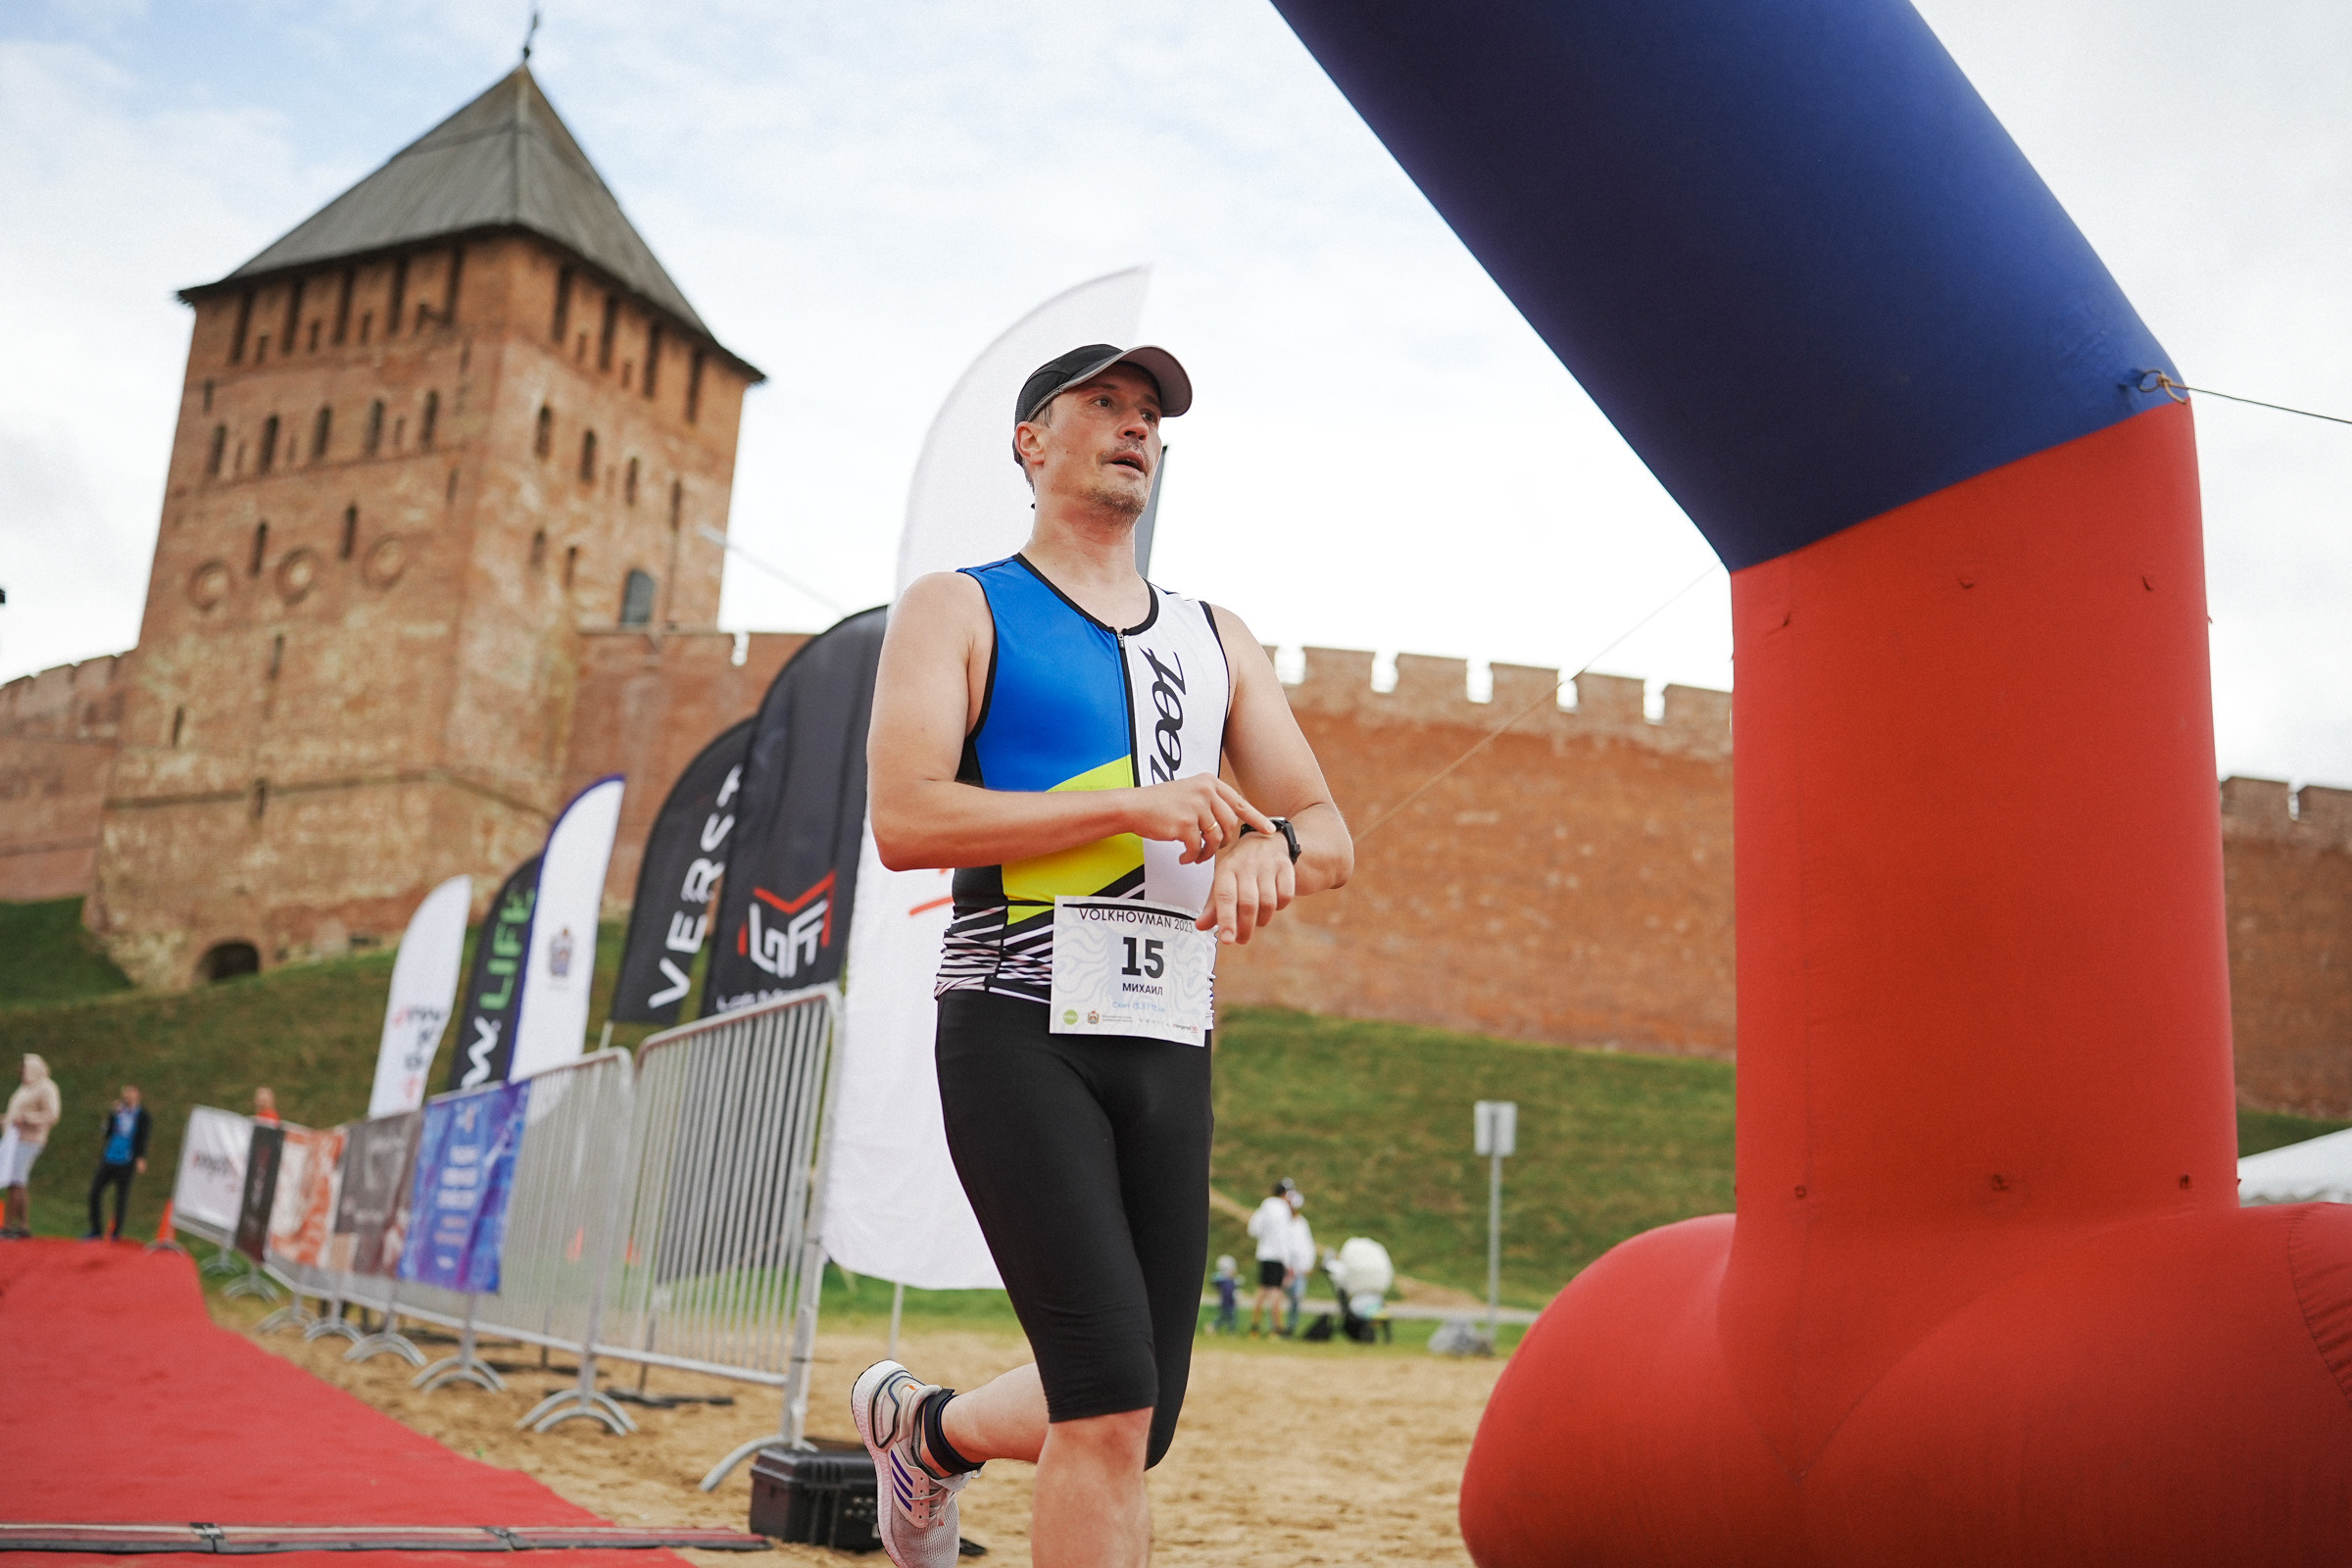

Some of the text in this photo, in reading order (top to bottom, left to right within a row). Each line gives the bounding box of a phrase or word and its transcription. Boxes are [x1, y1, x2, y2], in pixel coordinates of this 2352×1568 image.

[1079, 908, 1194, 934] VOLKHOVMAN 2023
[1121, 936, 1164, 979] 15
[1122, 982, 1163, 996] МИХАИЛ
